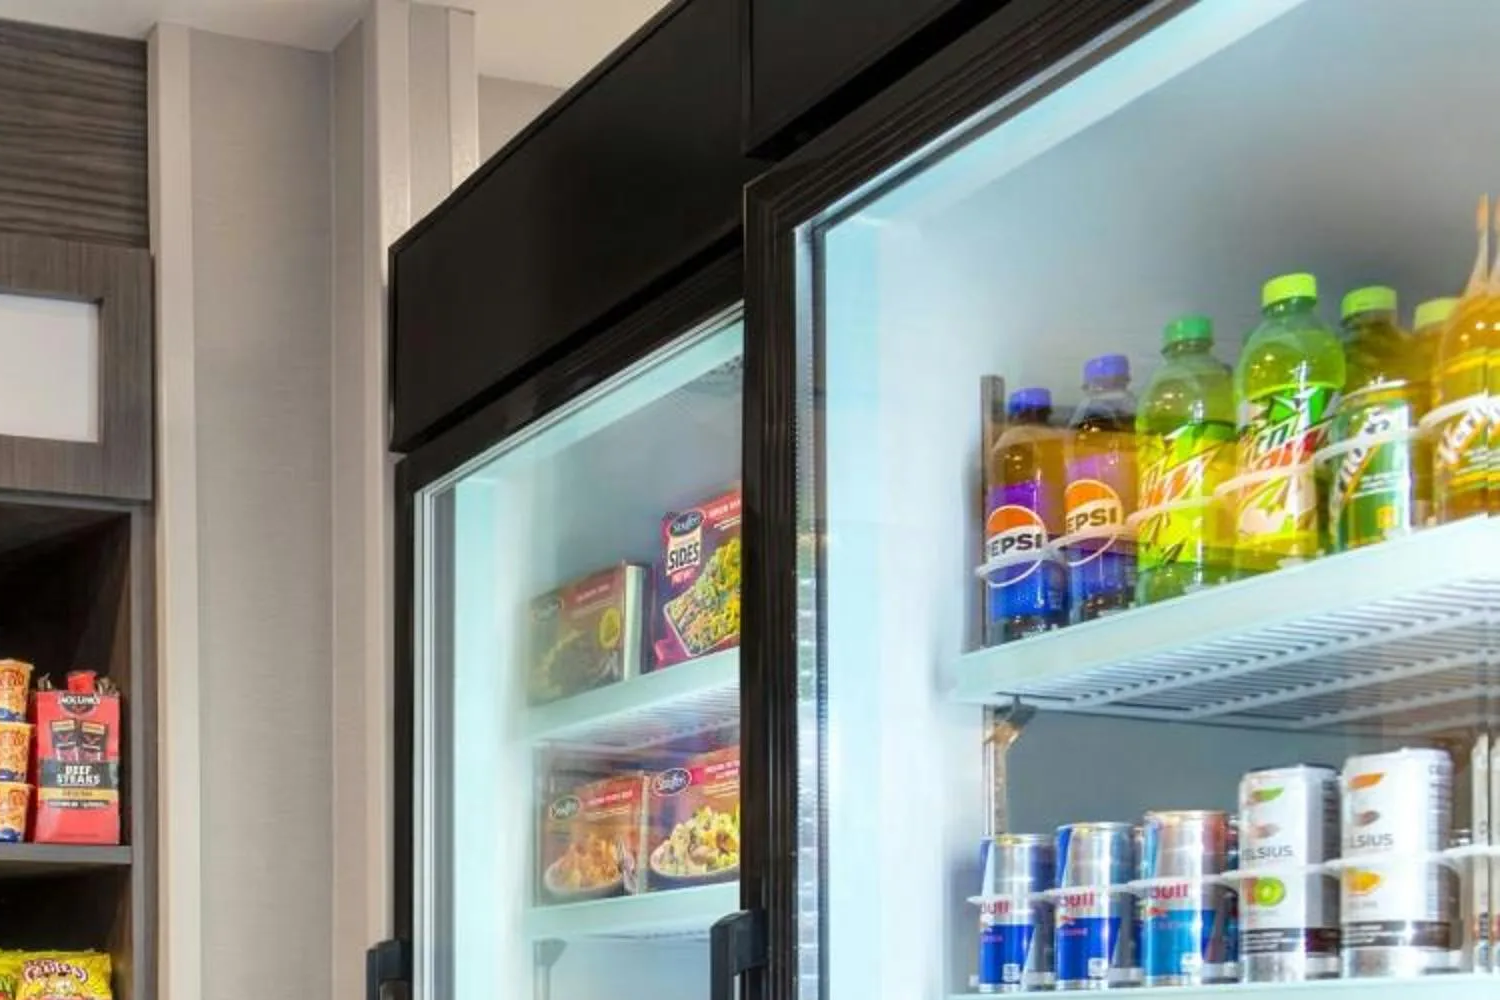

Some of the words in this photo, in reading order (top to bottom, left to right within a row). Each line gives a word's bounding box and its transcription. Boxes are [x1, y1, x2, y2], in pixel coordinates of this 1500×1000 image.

[1066, 506, 1117, 532] EPSI
[668, 542, 700, 569] SIDES
[988, 531, 1043, 556] EPSI
[56, 774, 101, 786] STEAKS
[65, 765, 92, 776] BEEF
